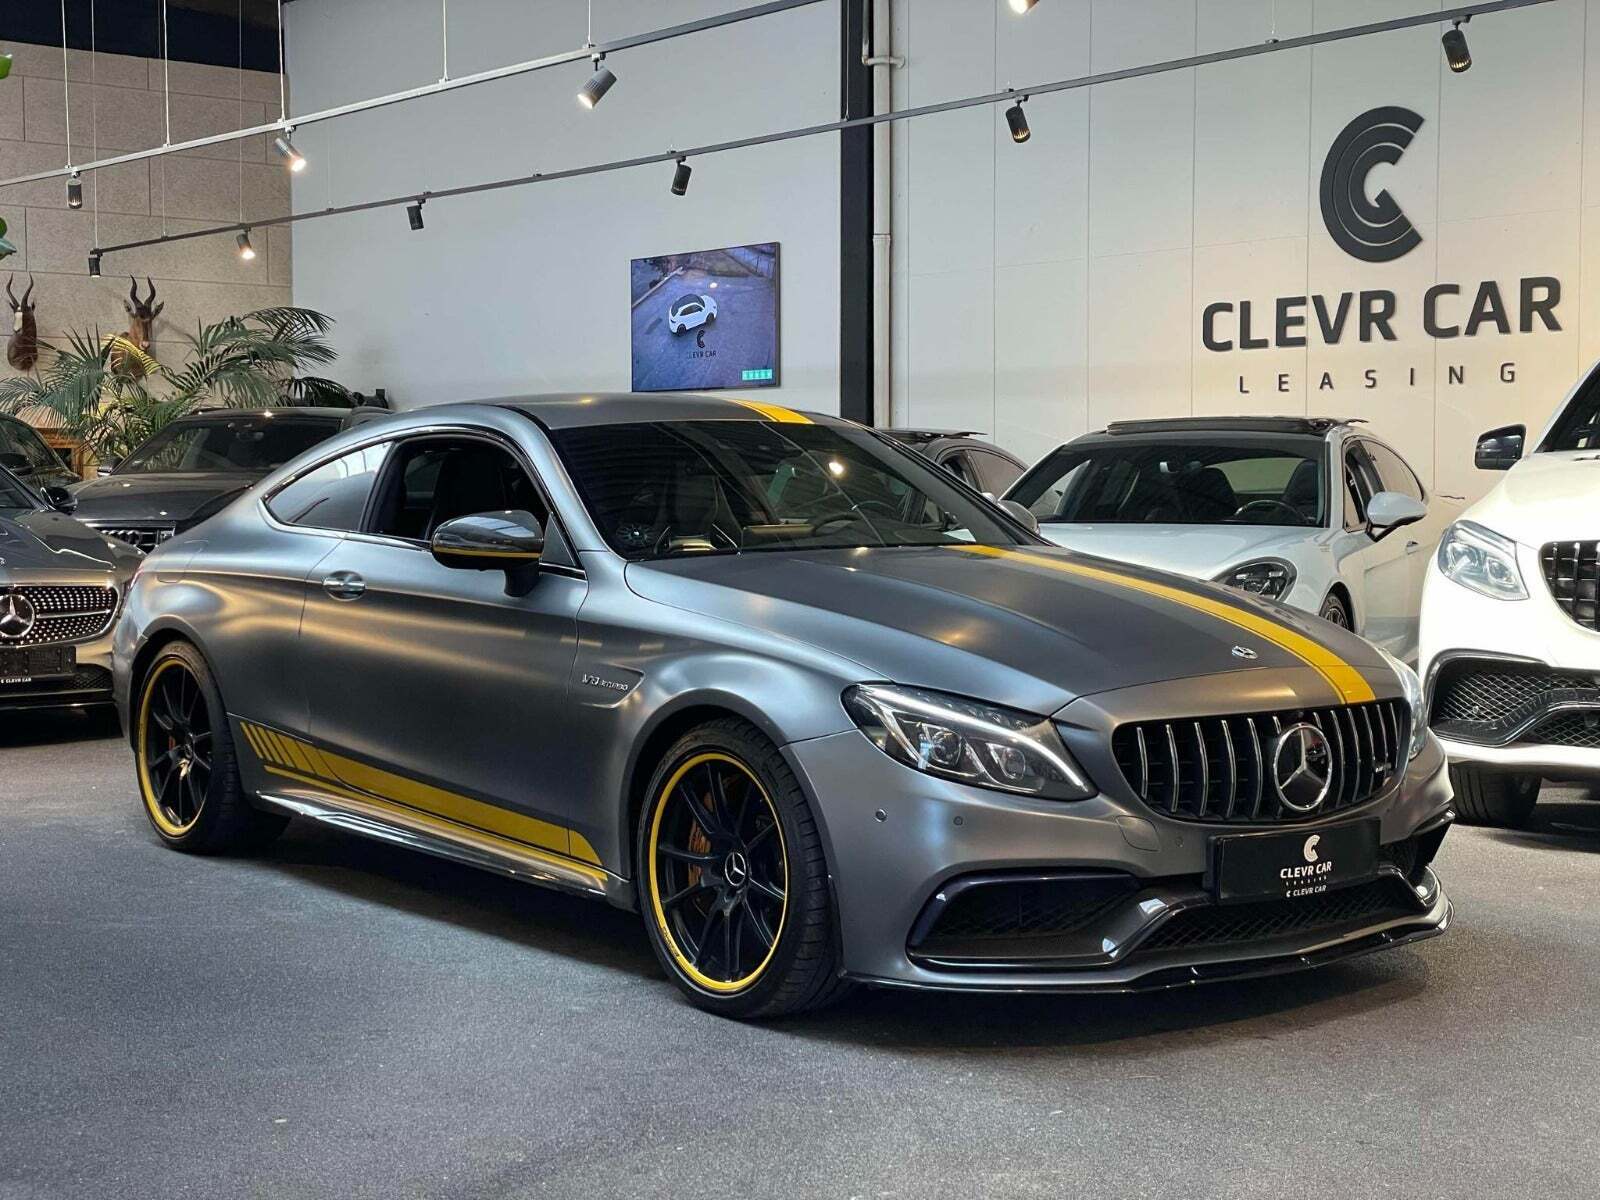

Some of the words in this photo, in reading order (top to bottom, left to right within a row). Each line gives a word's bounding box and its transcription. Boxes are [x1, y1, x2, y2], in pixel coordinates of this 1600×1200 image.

[1202, 289, 1397, 351] CLEVR
[1423, 275, 1562, 338] CAR
[1238, 362, 1517, 393] LEASING
[1280, 866, 1314, 878] CLEVR
[1316, 861, 1332, 874] CAR
[1293, 887, 1313, 896] CLEVR
[1315, 885, 1326, 893] CAR
